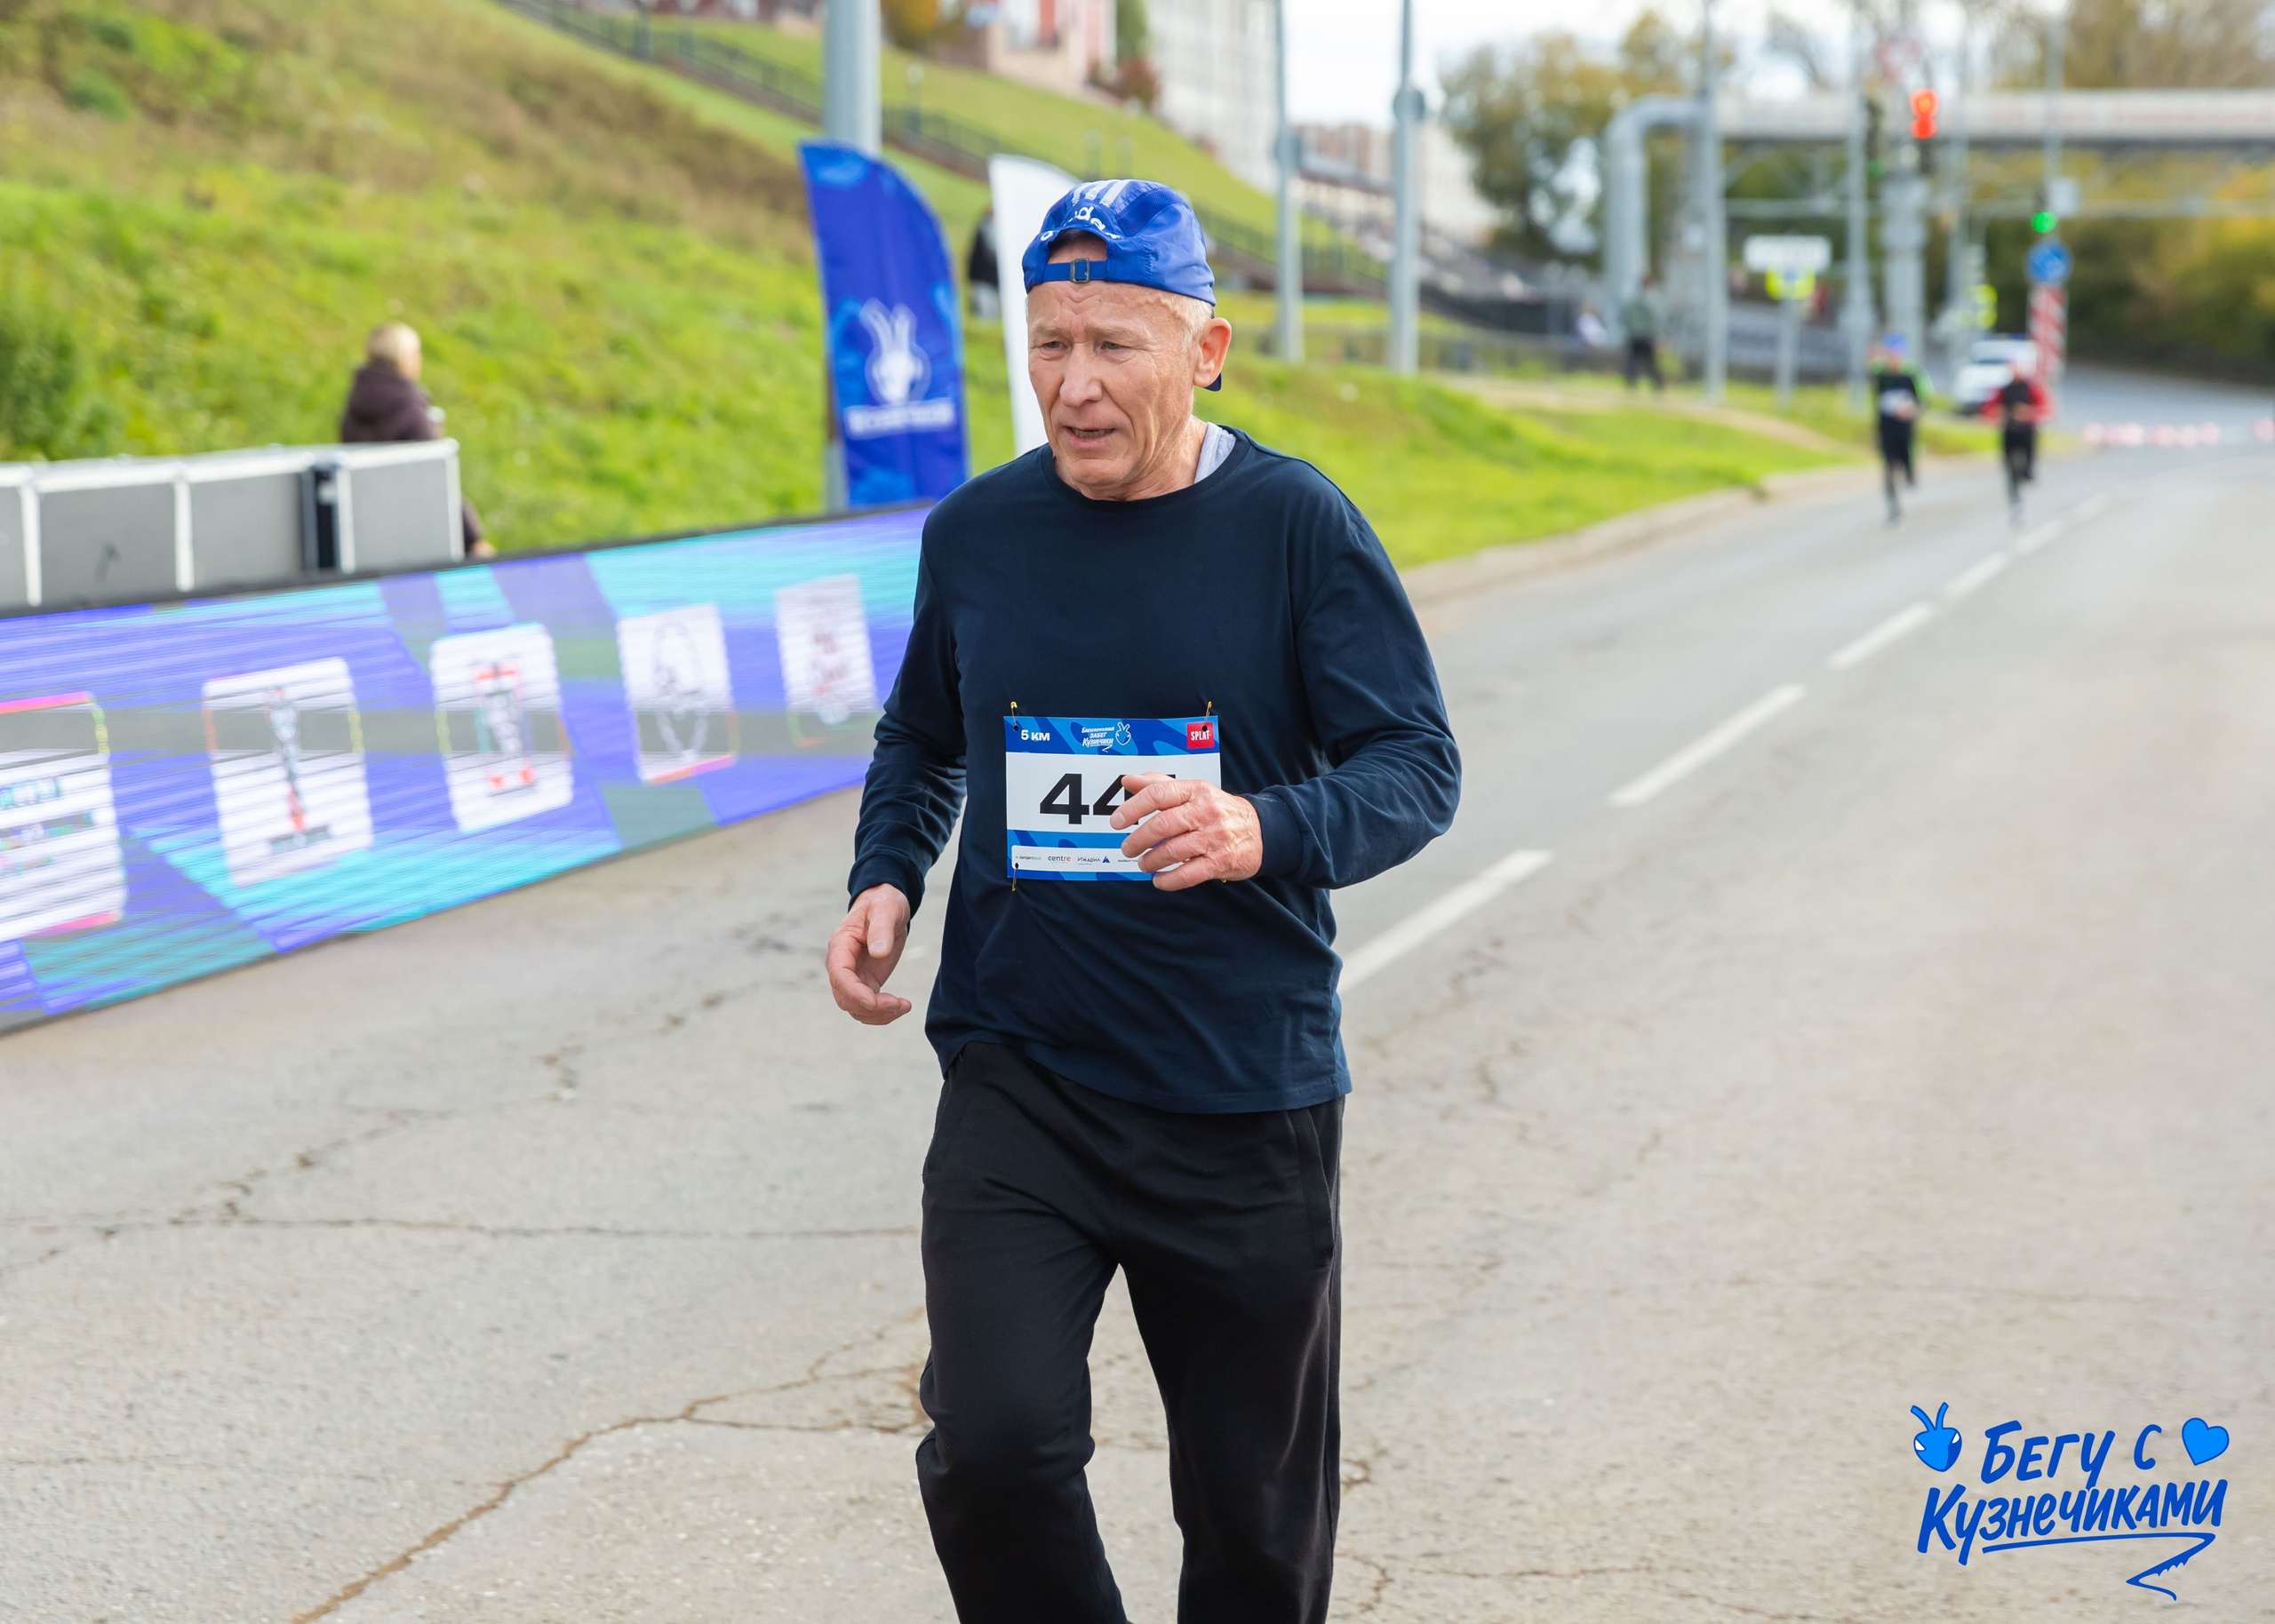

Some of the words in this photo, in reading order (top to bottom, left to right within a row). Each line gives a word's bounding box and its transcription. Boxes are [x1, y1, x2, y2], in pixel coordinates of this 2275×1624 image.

[1020, 728, 1030, 741] 5
[1191, 729, 1210, 741] SPLAT
[1040, 773, 1176, 825] 44
